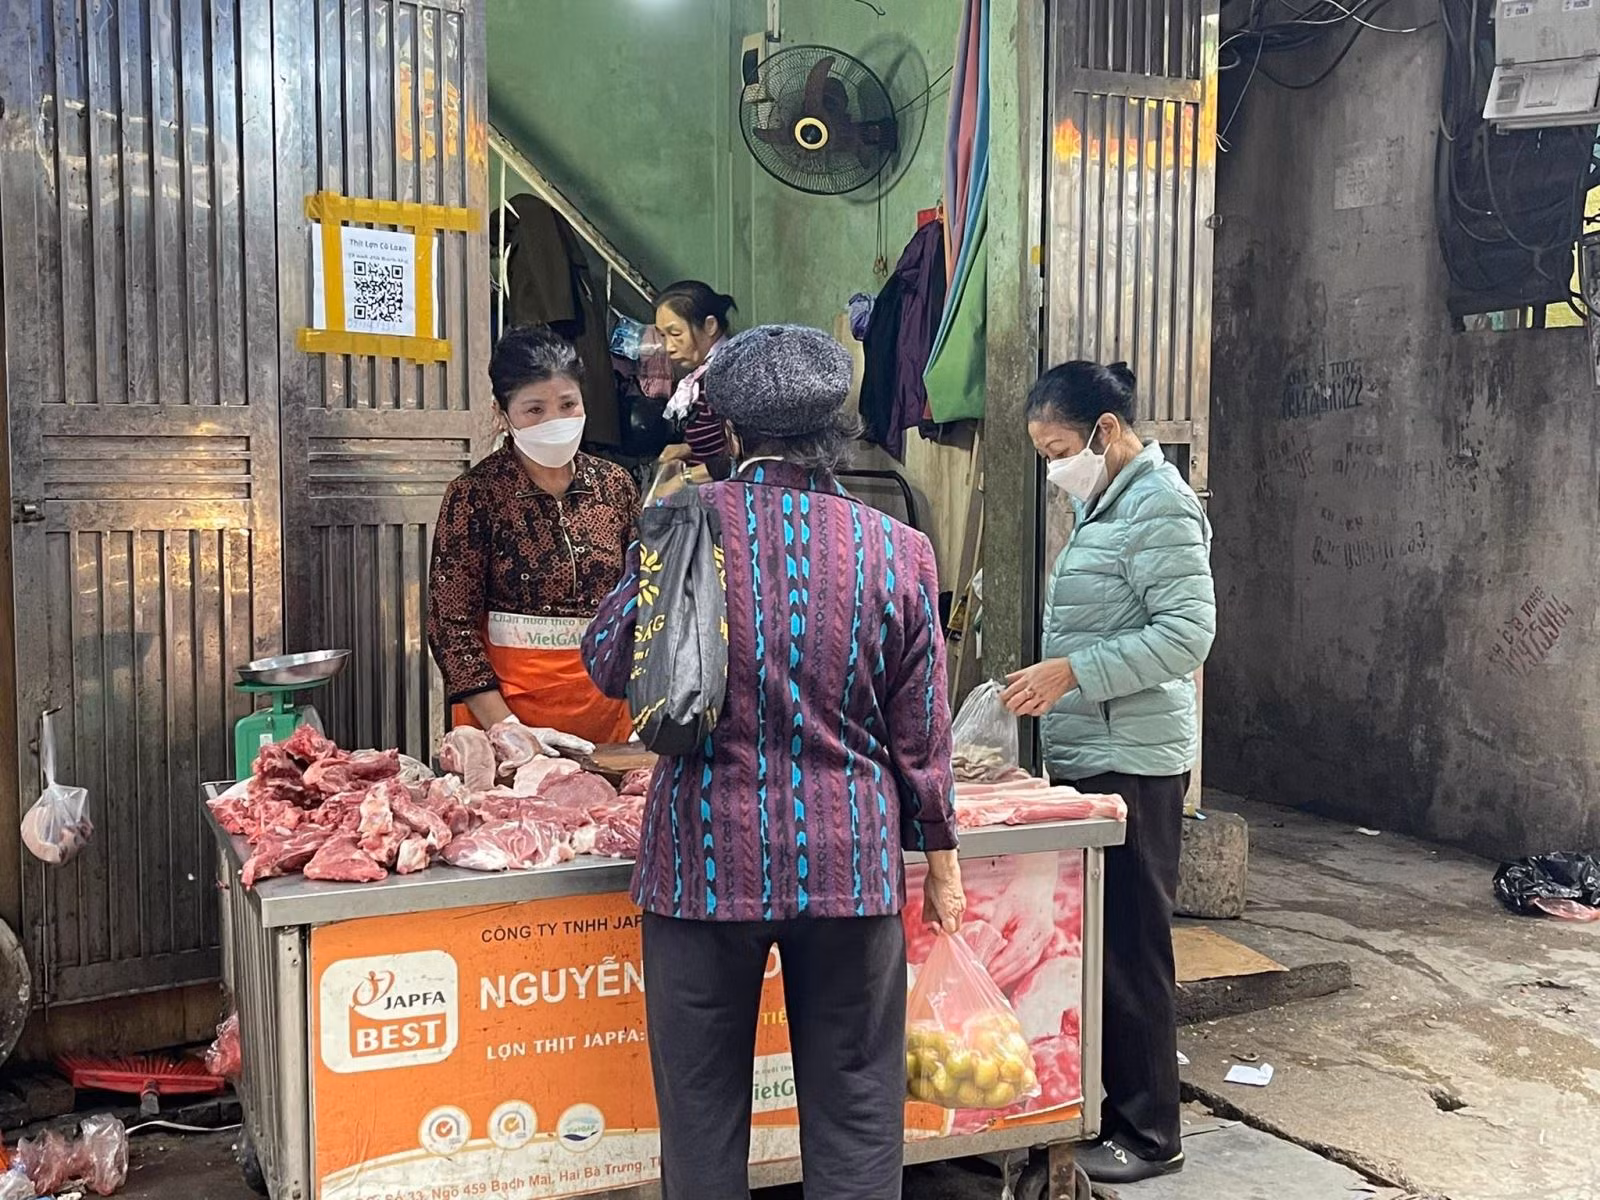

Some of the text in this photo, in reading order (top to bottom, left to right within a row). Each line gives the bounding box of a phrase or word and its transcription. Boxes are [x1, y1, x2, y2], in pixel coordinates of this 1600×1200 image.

[481, 915, 643, 942] CÔNG TY TNHH JAP
[480, 955, 645, 1011] NGUYỄN
[384, 991, 446, 1010] JAPFA
[760, 1008, 787, 1027] TIỆ
[356, 1020, 441, 1053] BEST
[487, 1029, 645, 1061] LỢN THỊT JAPFA:
[755, 1078, 794, 1100] ietG
[463, 1183, 487, 1195] 459
[559, 1170, 580, 1182] Hai
[584, 1166, 600, 1178] Bà
